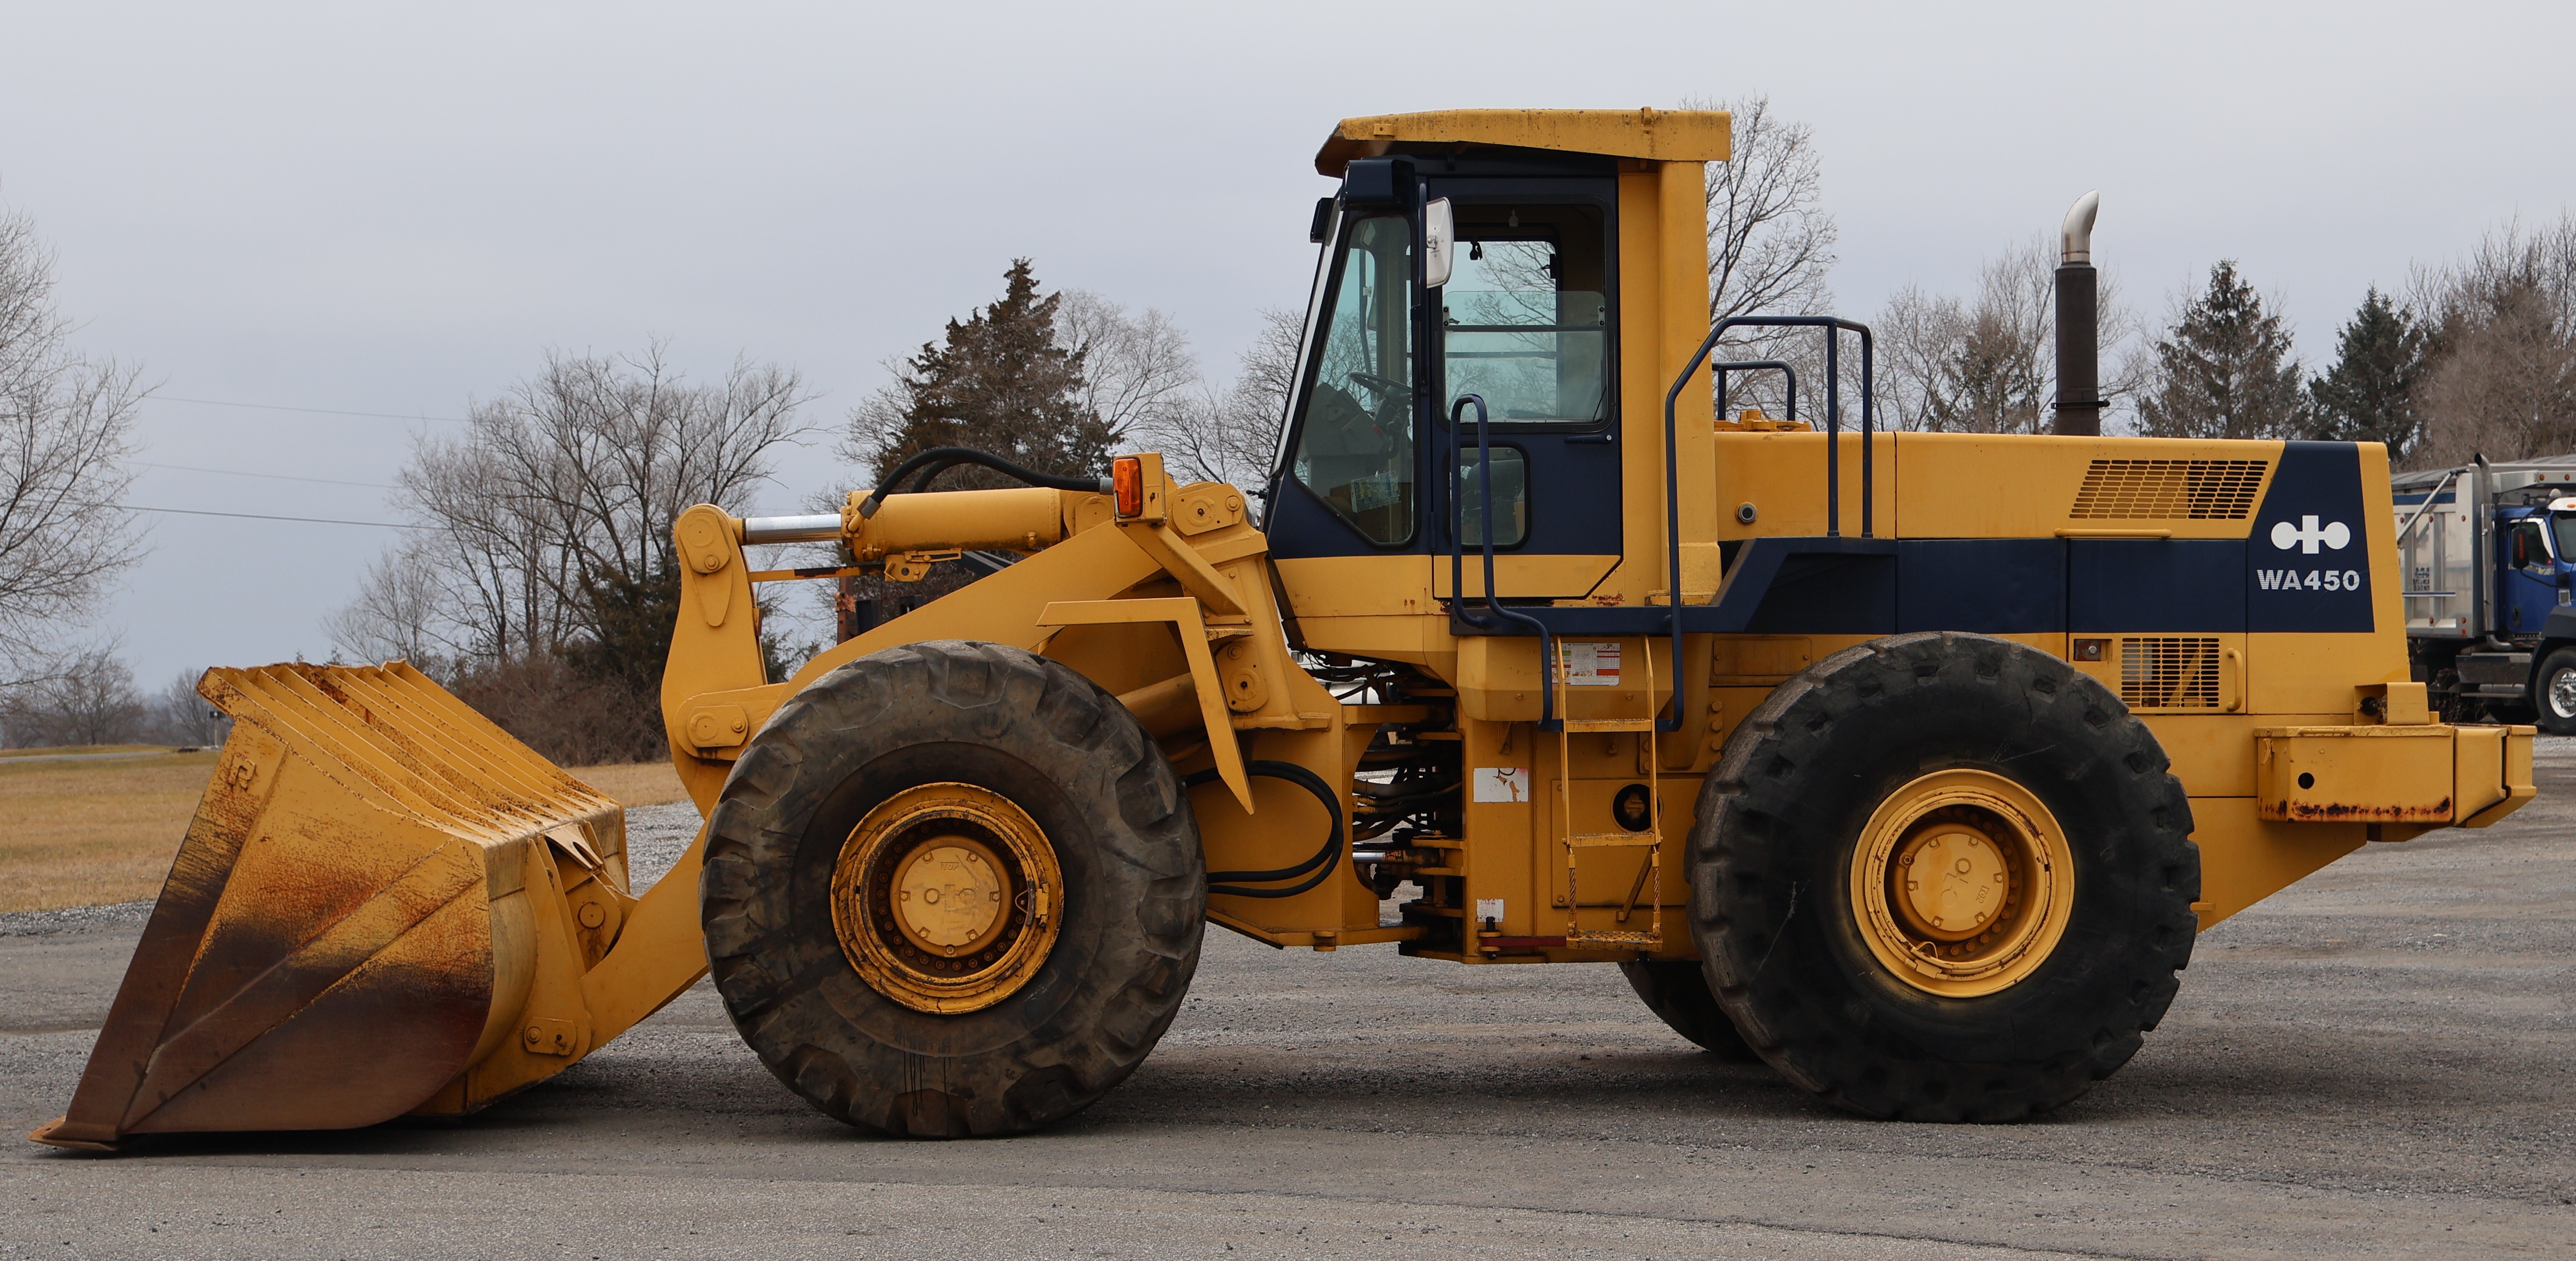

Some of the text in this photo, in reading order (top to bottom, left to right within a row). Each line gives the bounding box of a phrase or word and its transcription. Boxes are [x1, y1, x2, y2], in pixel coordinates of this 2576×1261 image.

[2256, 569, 2360, 591] WA450
[228, 753, 256, 789] R
[1976, 886, 1989, 903] TOP
